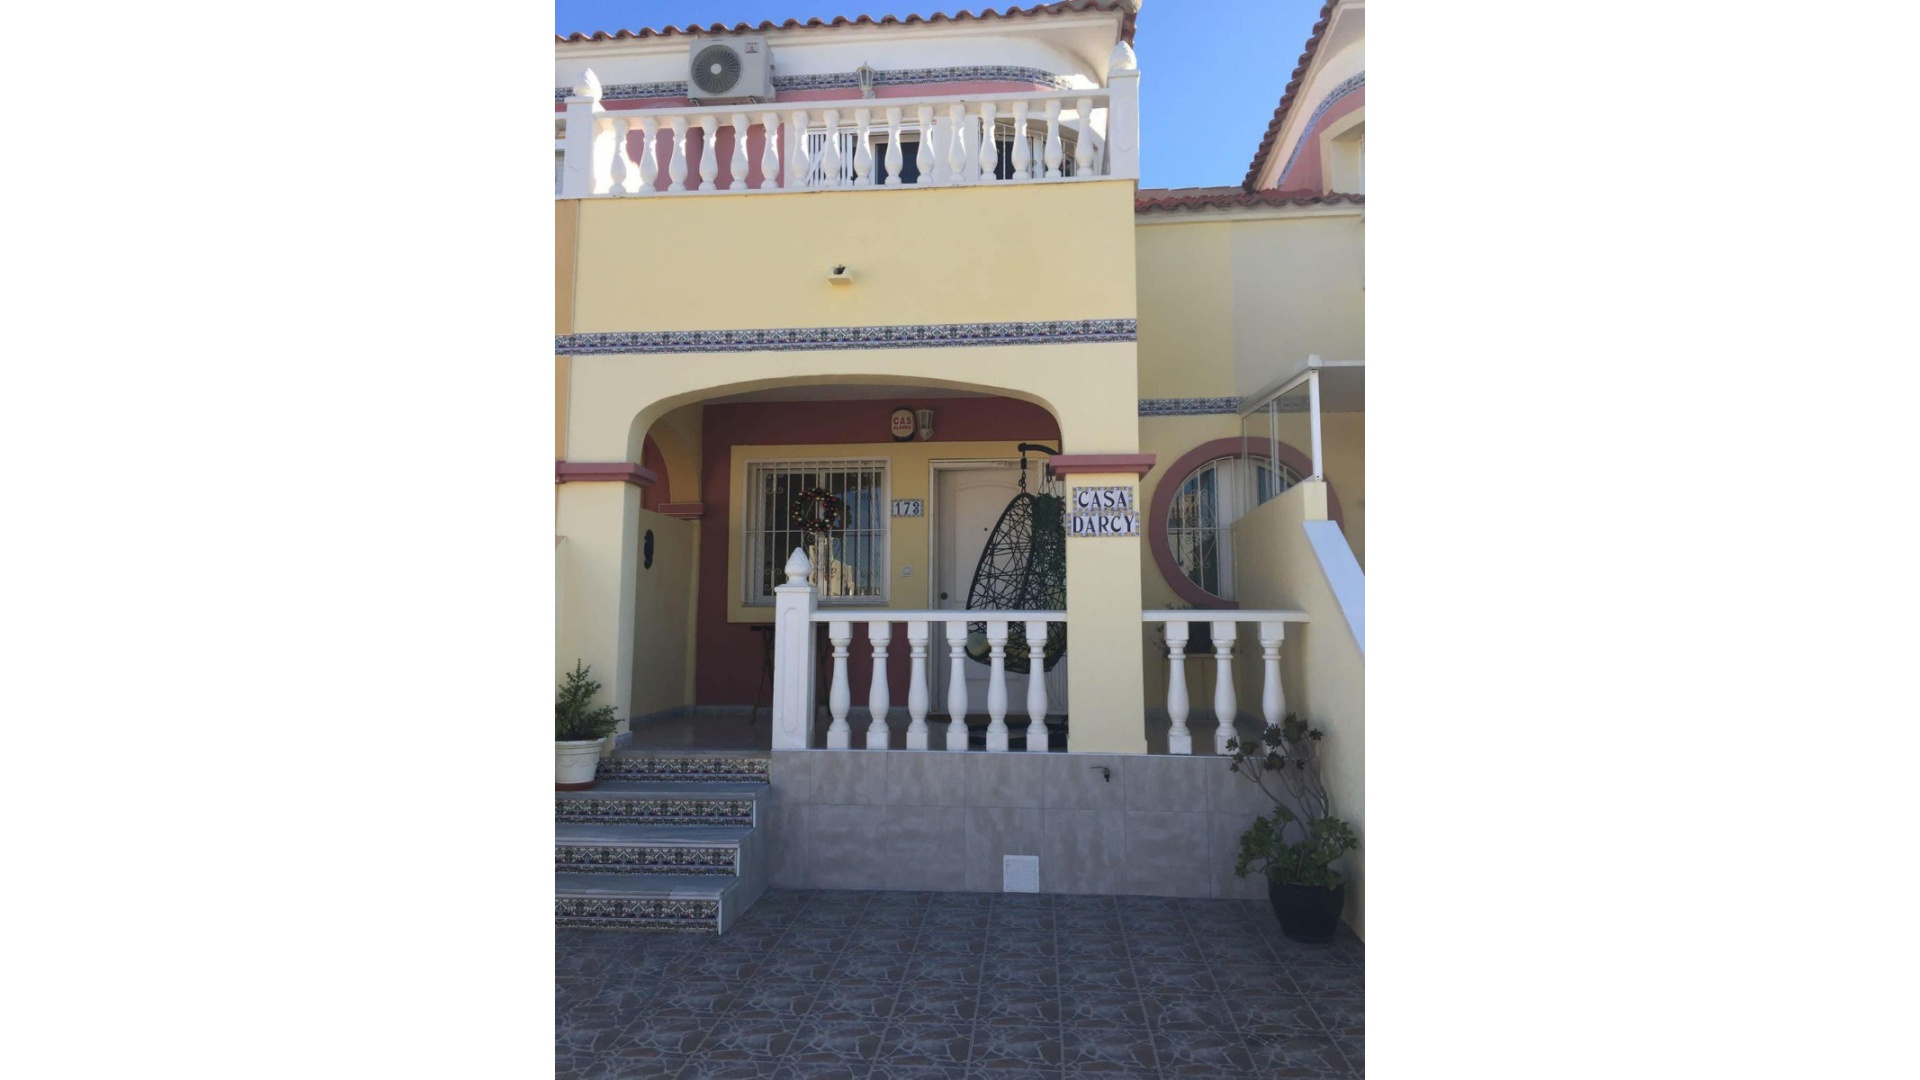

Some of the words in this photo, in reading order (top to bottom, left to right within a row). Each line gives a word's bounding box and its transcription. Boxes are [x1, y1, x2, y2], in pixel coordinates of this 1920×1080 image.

[893, 416, 912, 425] CAS
[1078, 490, 1127, 508] CASA
[895, 501, 920, 515] 173
[1073, 514, 1134, 533] DARCY
